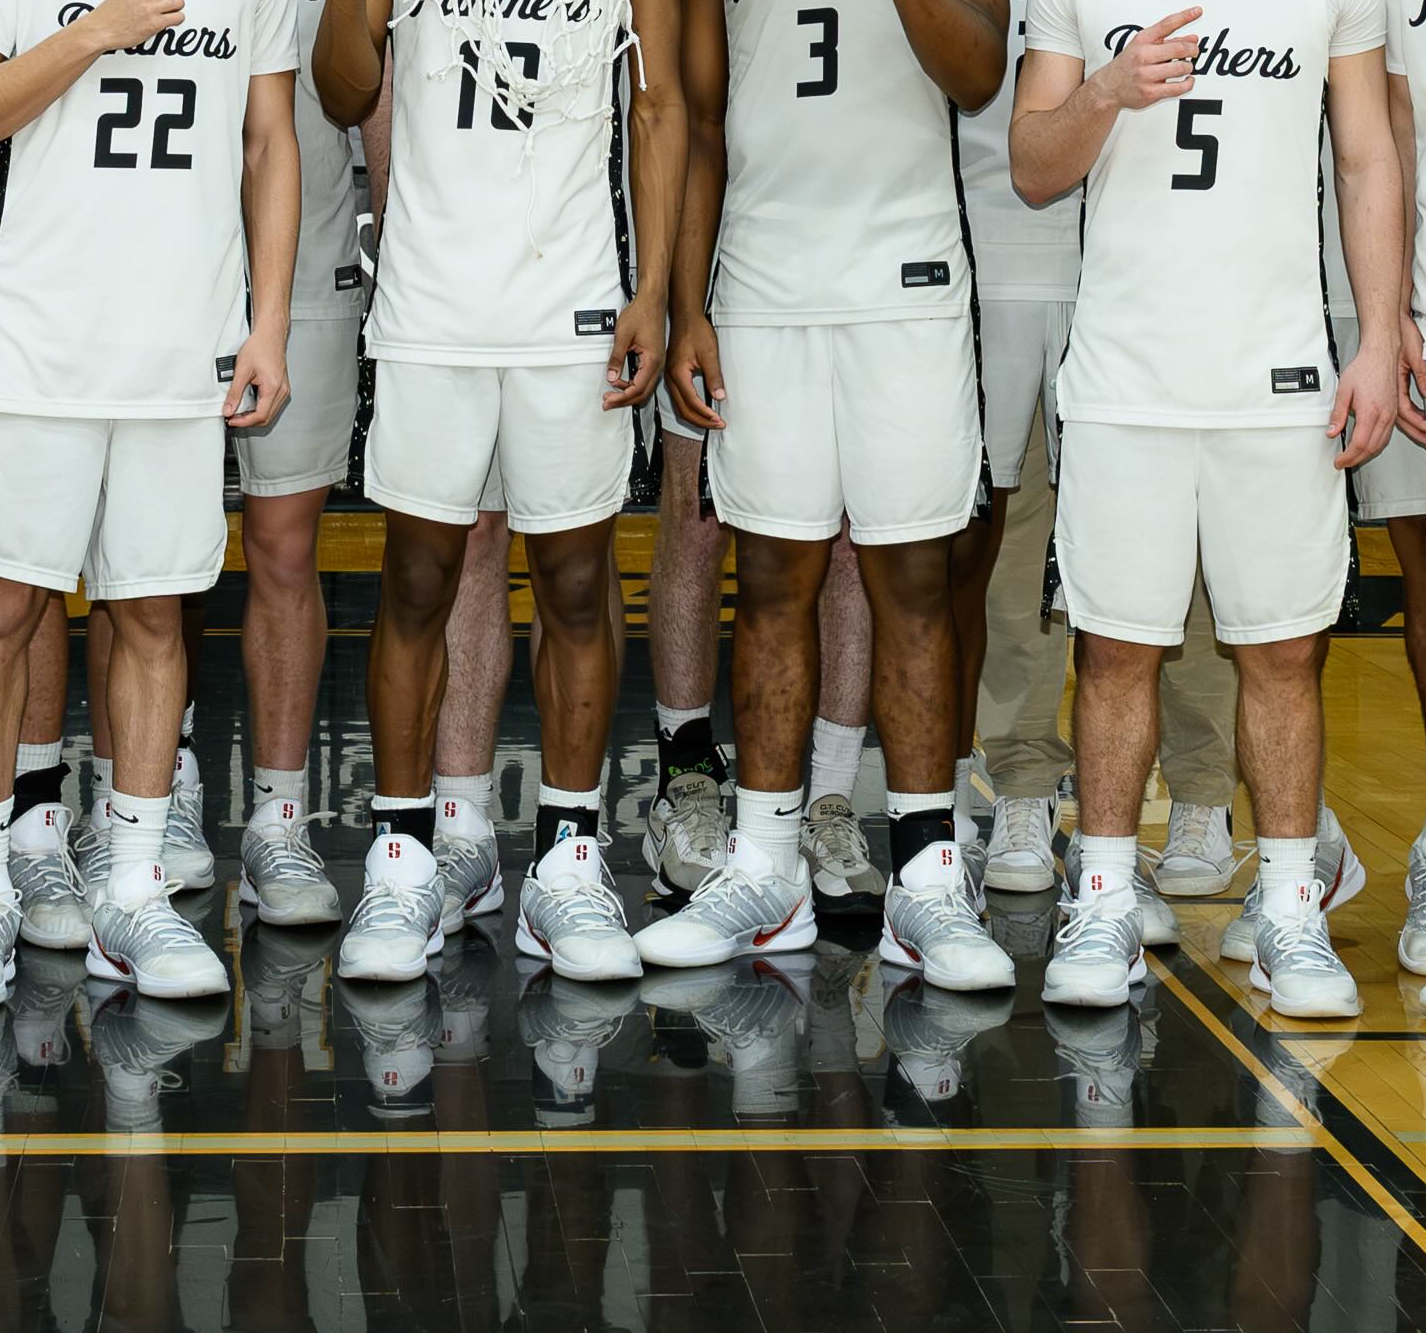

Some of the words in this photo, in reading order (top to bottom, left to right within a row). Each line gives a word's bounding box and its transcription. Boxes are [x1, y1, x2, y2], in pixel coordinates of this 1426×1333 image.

[796, 7, 839, 98] 3
[1104, 24, 1301, 80] Pthers
[94, 78, 197, 169] 22
[1171, 99, 1223, 191] 5
